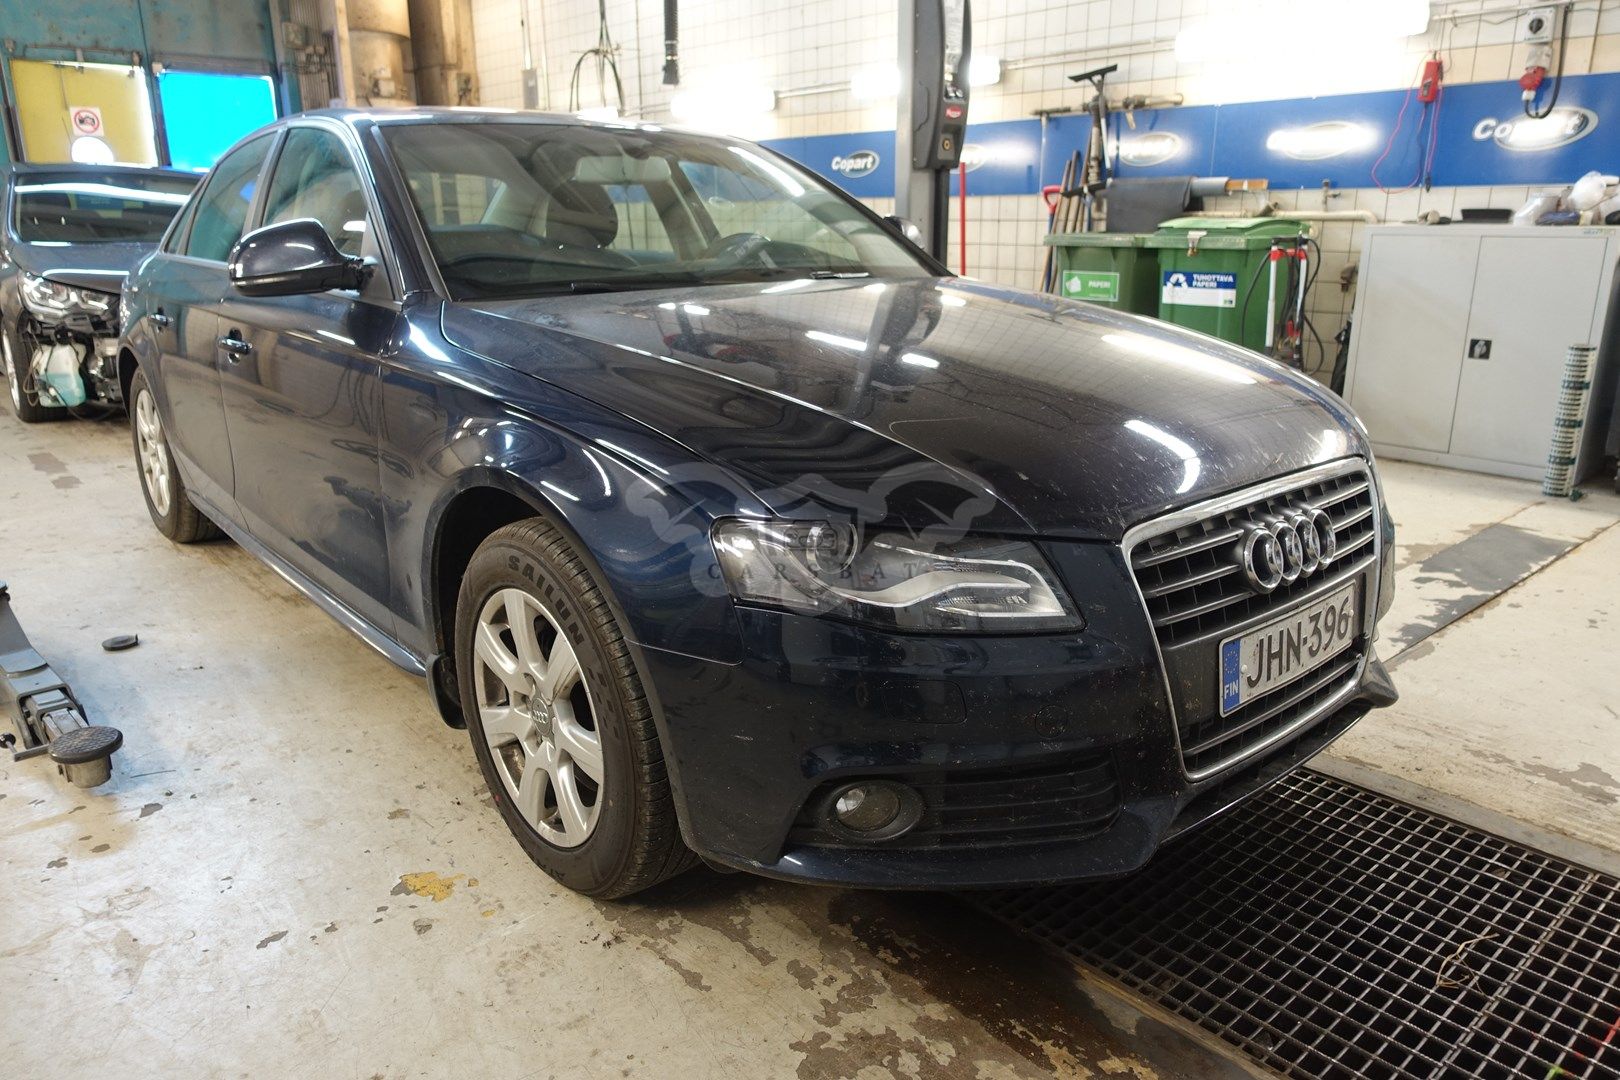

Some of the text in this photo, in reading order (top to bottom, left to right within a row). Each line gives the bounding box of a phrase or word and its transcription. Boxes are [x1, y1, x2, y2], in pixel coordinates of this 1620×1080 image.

[831, 155, 874, 172] Copart
[508, 555, 585, 645] SAILUN
[1246, 595, 1350, 688] JHN-396
[1224, 679, 1239, 700] FIN
